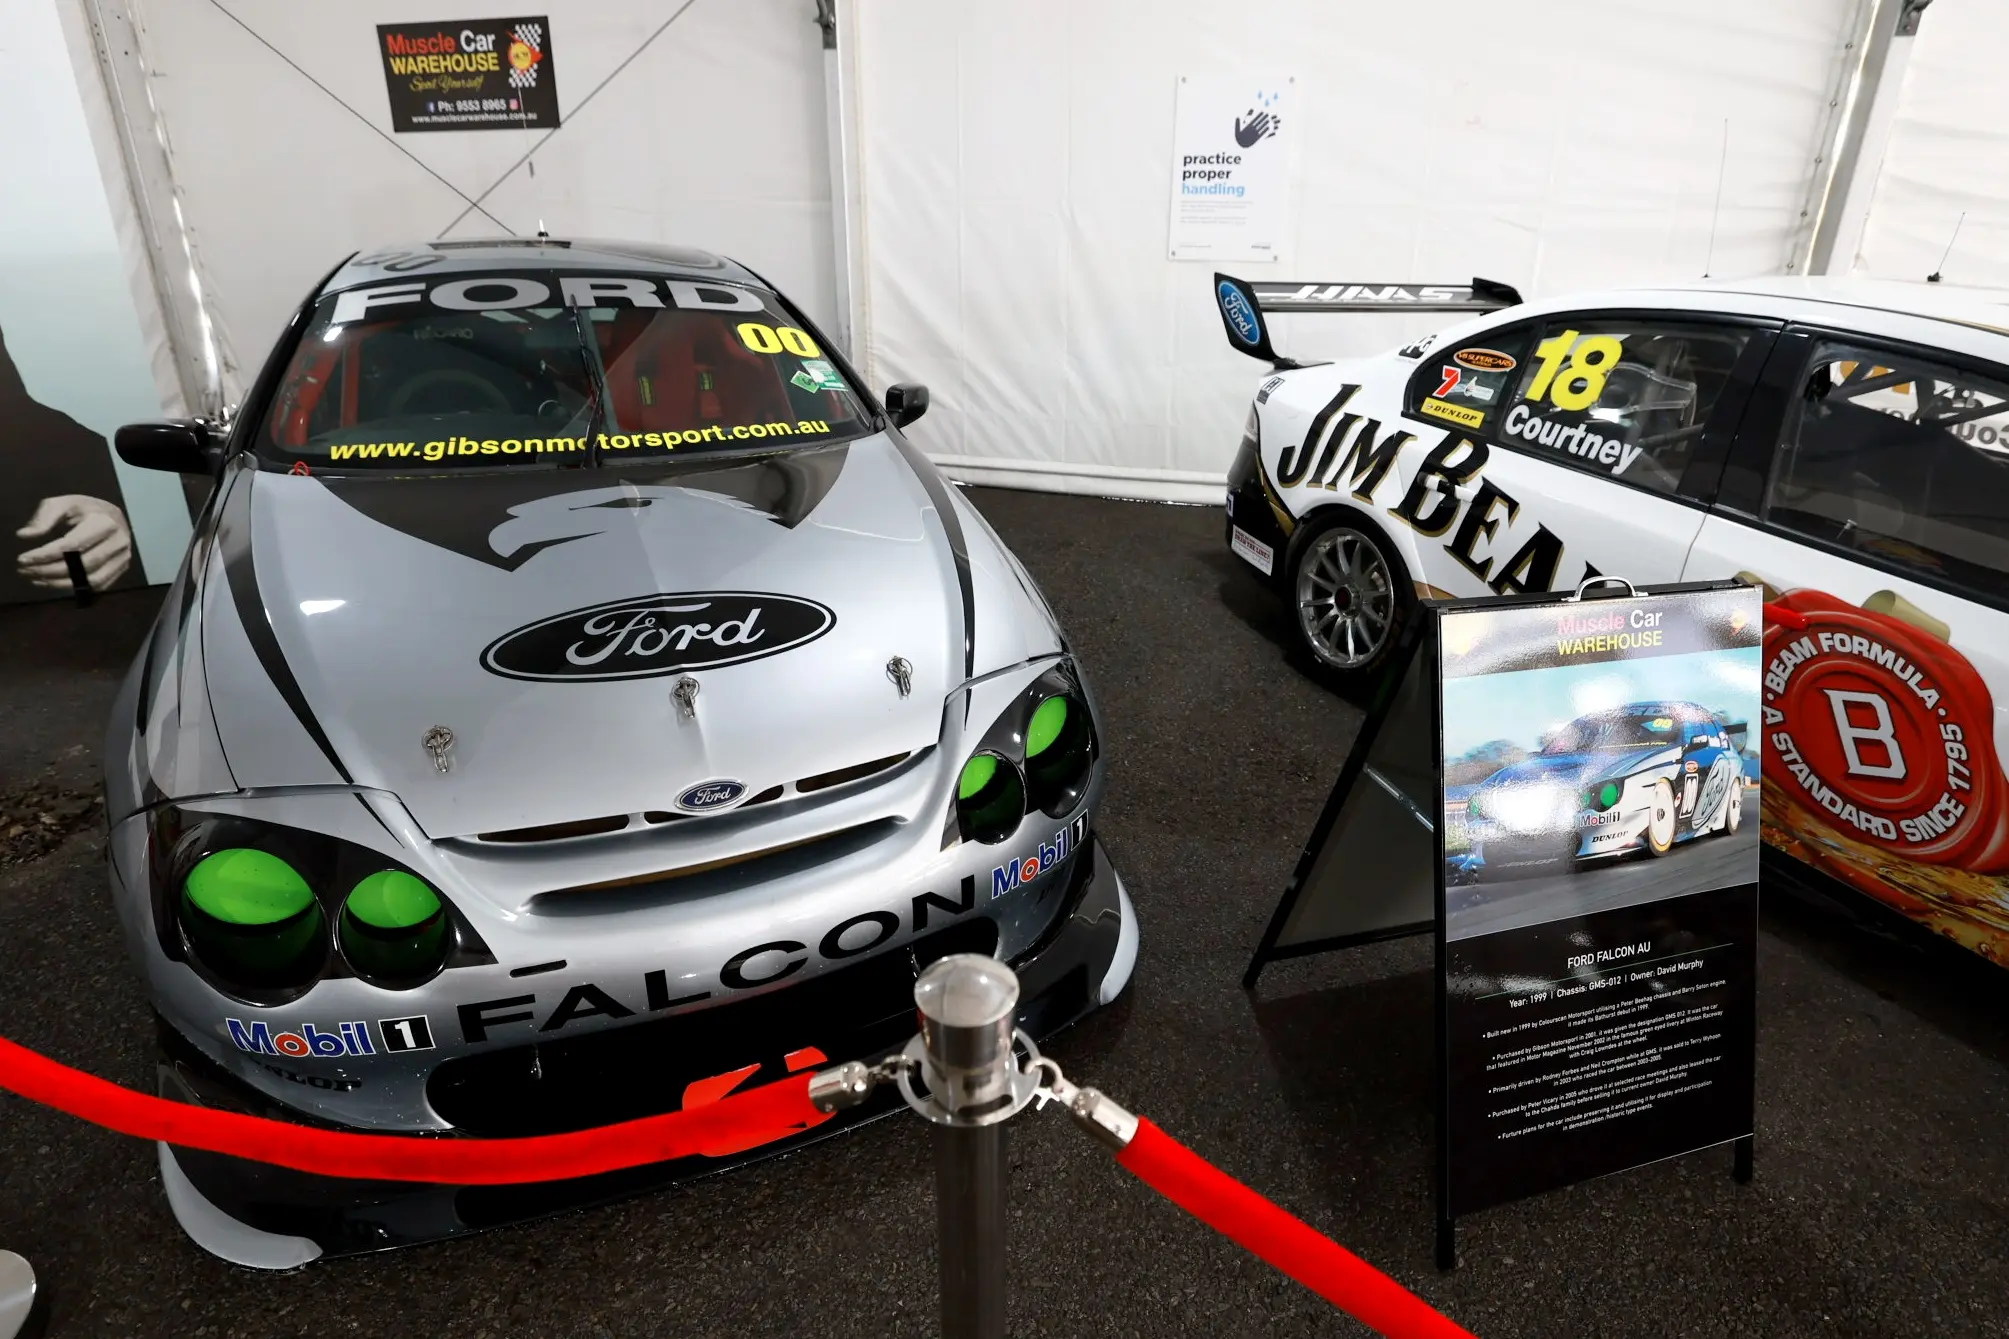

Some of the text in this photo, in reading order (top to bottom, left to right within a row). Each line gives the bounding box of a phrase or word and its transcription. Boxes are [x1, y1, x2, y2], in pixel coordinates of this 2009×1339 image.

[386, 30, 496, 55] Muscle Car
[389, 52, 500, 75] WAREHOUSE
[411, 112, 538, 124] www.musclecarwarehouse.com.au
[437, 100, 455, 112] Ph:
[1182, 169, 1232, 182] proper
[1183, 152, 1242, 167] practice
[1181, 183, 1245, 198] handling
[330, 277, 766, 325] FORD
[1224, 291, 1249, 337] Ford
[736, 322, 821, 359] 00
[1469, 353, 1513, 367] SUPERCARS
[1524, 329, 1624, 412] 18
[1433, 366, 1460, 397] 7
[1434, 405, 1478, 421] DUNLOP
[1505, 404, 1644, 476] Courtney
[1277, 384, 1606, 594] JIM BEA
[565, 602, 766, 667] Ford
[1557, 609, 1663, 635] Muscle Car
[1556, 631, 1663, 656] WAREHOUSE
[1764, 632, 1941, 711] BEAM FORMULA
[1763, 709, 1784, 726] A
[1823, 689, 1907, 779] B
[1939, 723, 1973, 792] 1795
[694, 786, 732, 808] Ford
[1772, 732, 1898, 842] STANDARD
[1900, 793, 1967, 843] SINCE
[1592, 830, 1629, 843] DUNLOP
[991, 826, 1069, 900] Mobil
[457, 874, 976, 1044] FALCON
[1567, 941, 1651, 969] FORD FALCON AU
[1509, 959, 1704, 1008] Year: 1999 Chassis: GMS-012 Owner: David Murphy
[224, 1016, 377, 1058] Mobil
